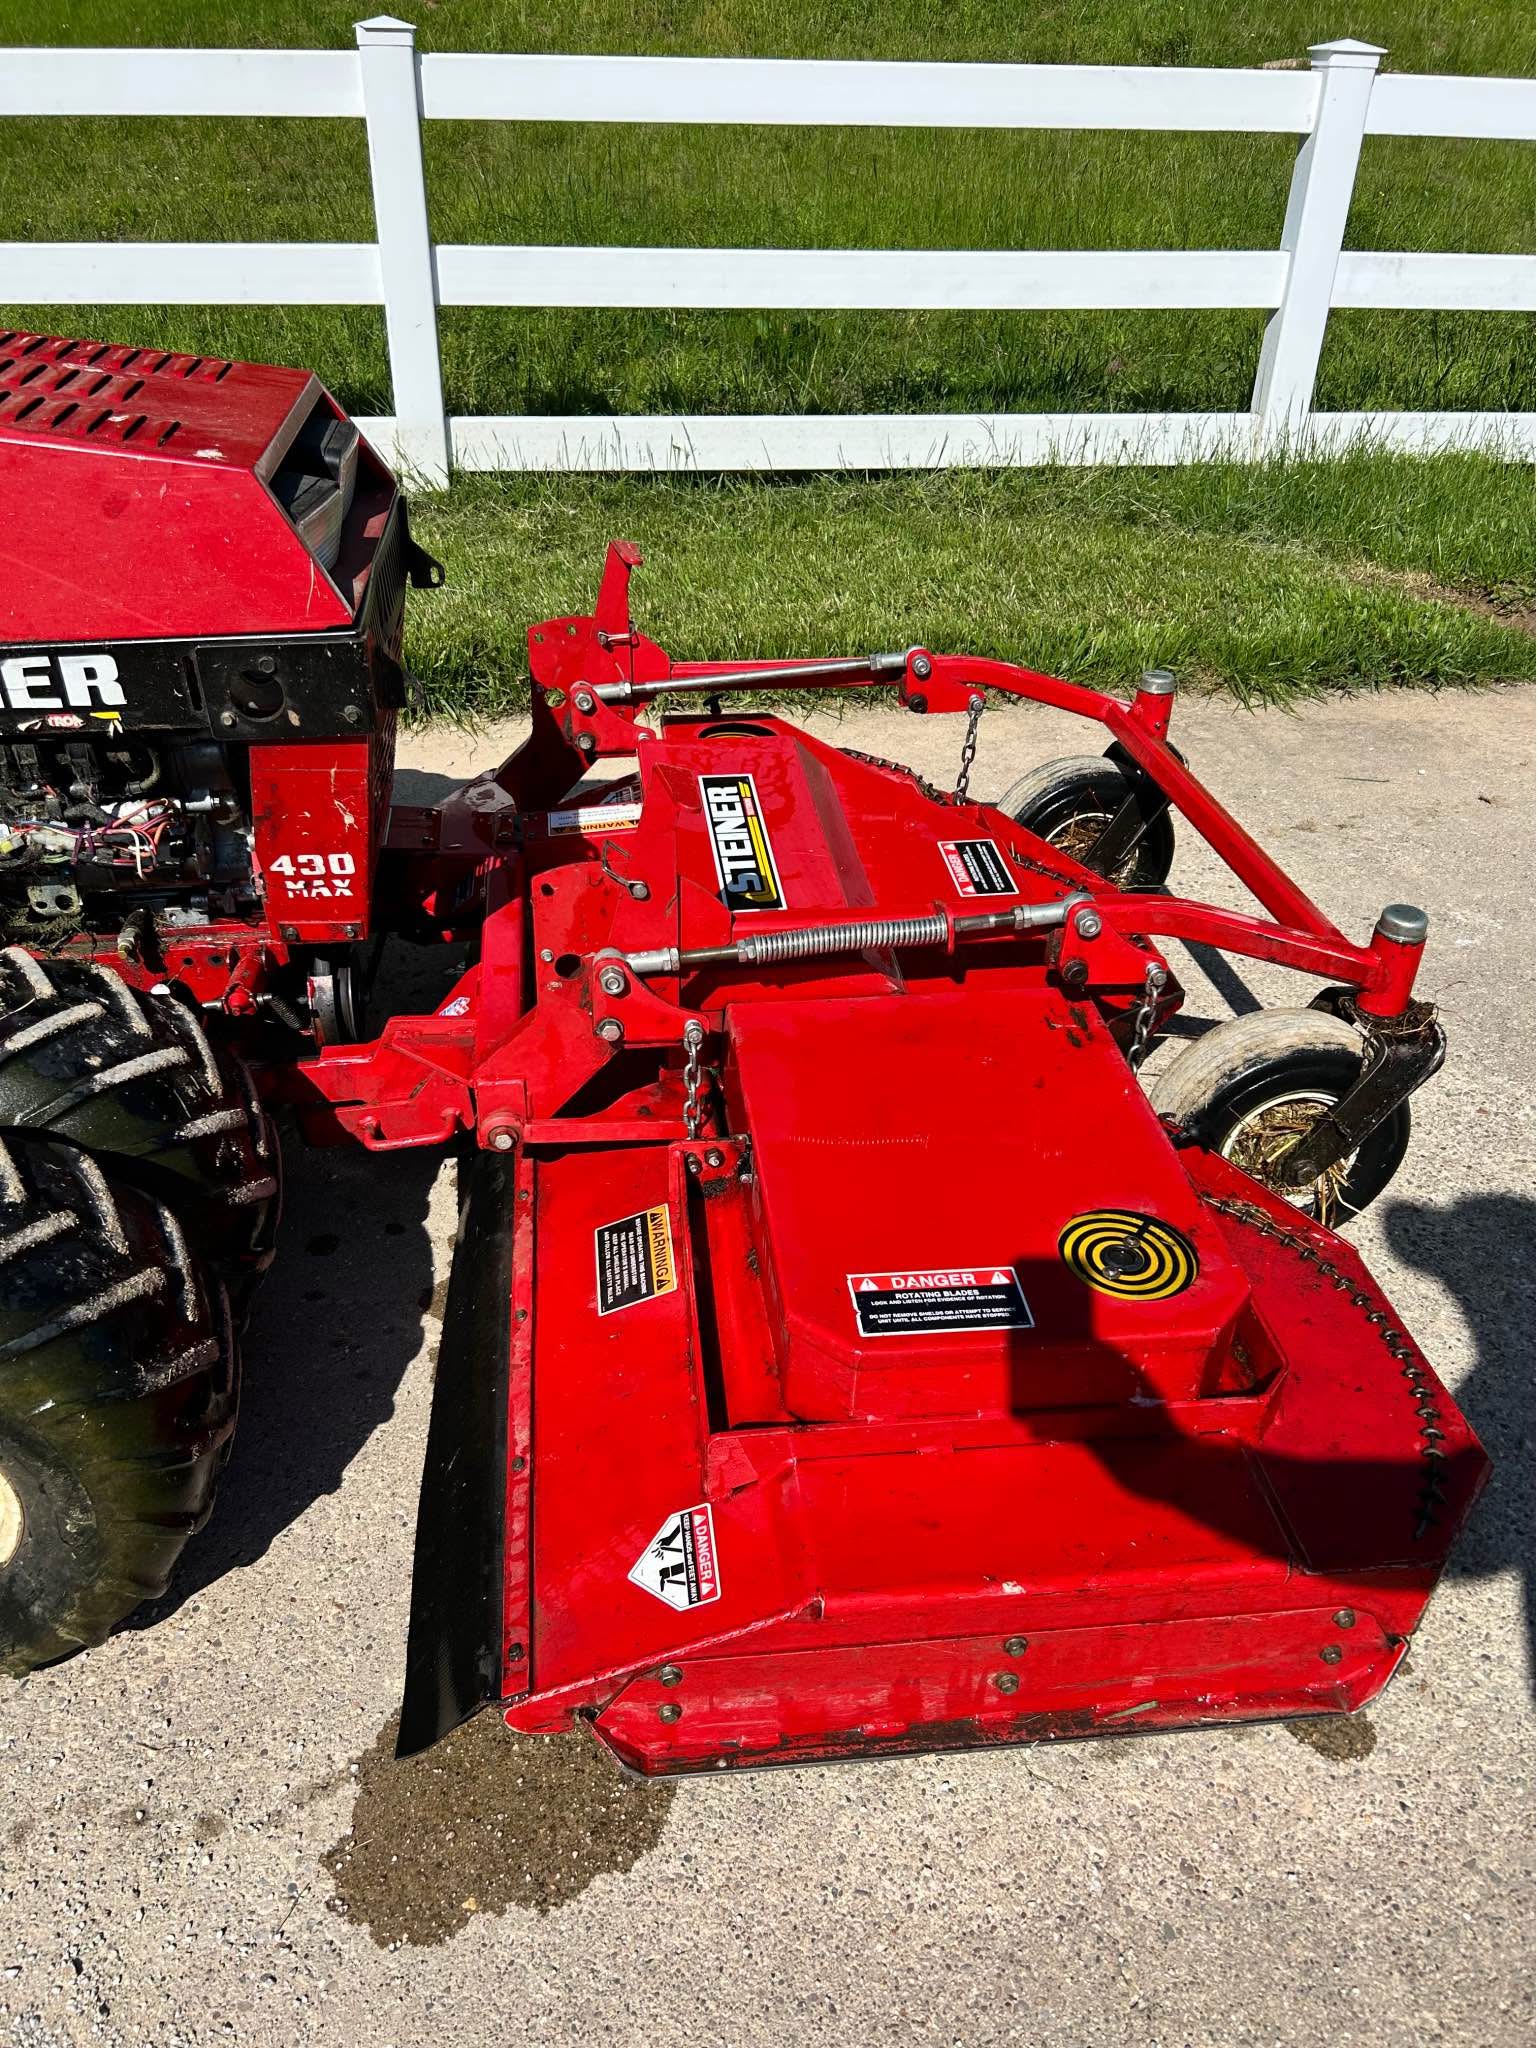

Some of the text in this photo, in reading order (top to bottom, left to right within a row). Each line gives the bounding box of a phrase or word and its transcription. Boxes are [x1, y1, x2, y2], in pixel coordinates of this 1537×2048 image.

[0, 655, 128, 709] ER
[706, 786, 763, 892] STEINER
[269, 853, 356, 876] 430
[948, 854, 970, 882] DANGER
[284, 879, 354, 899] MAX
[651, 1219, 668, 1278] WARNING
[890, 1273, 977, 1289] DANGER
[894, 1291, 942, 1299] ROTATING
[685, 1530, 693, 1553] HANDS
[696, 1525, 712, 1581] DANGER
[688, 1565, 696, 1582] FEET
[690, 1581, 698, 1602] AWAY
